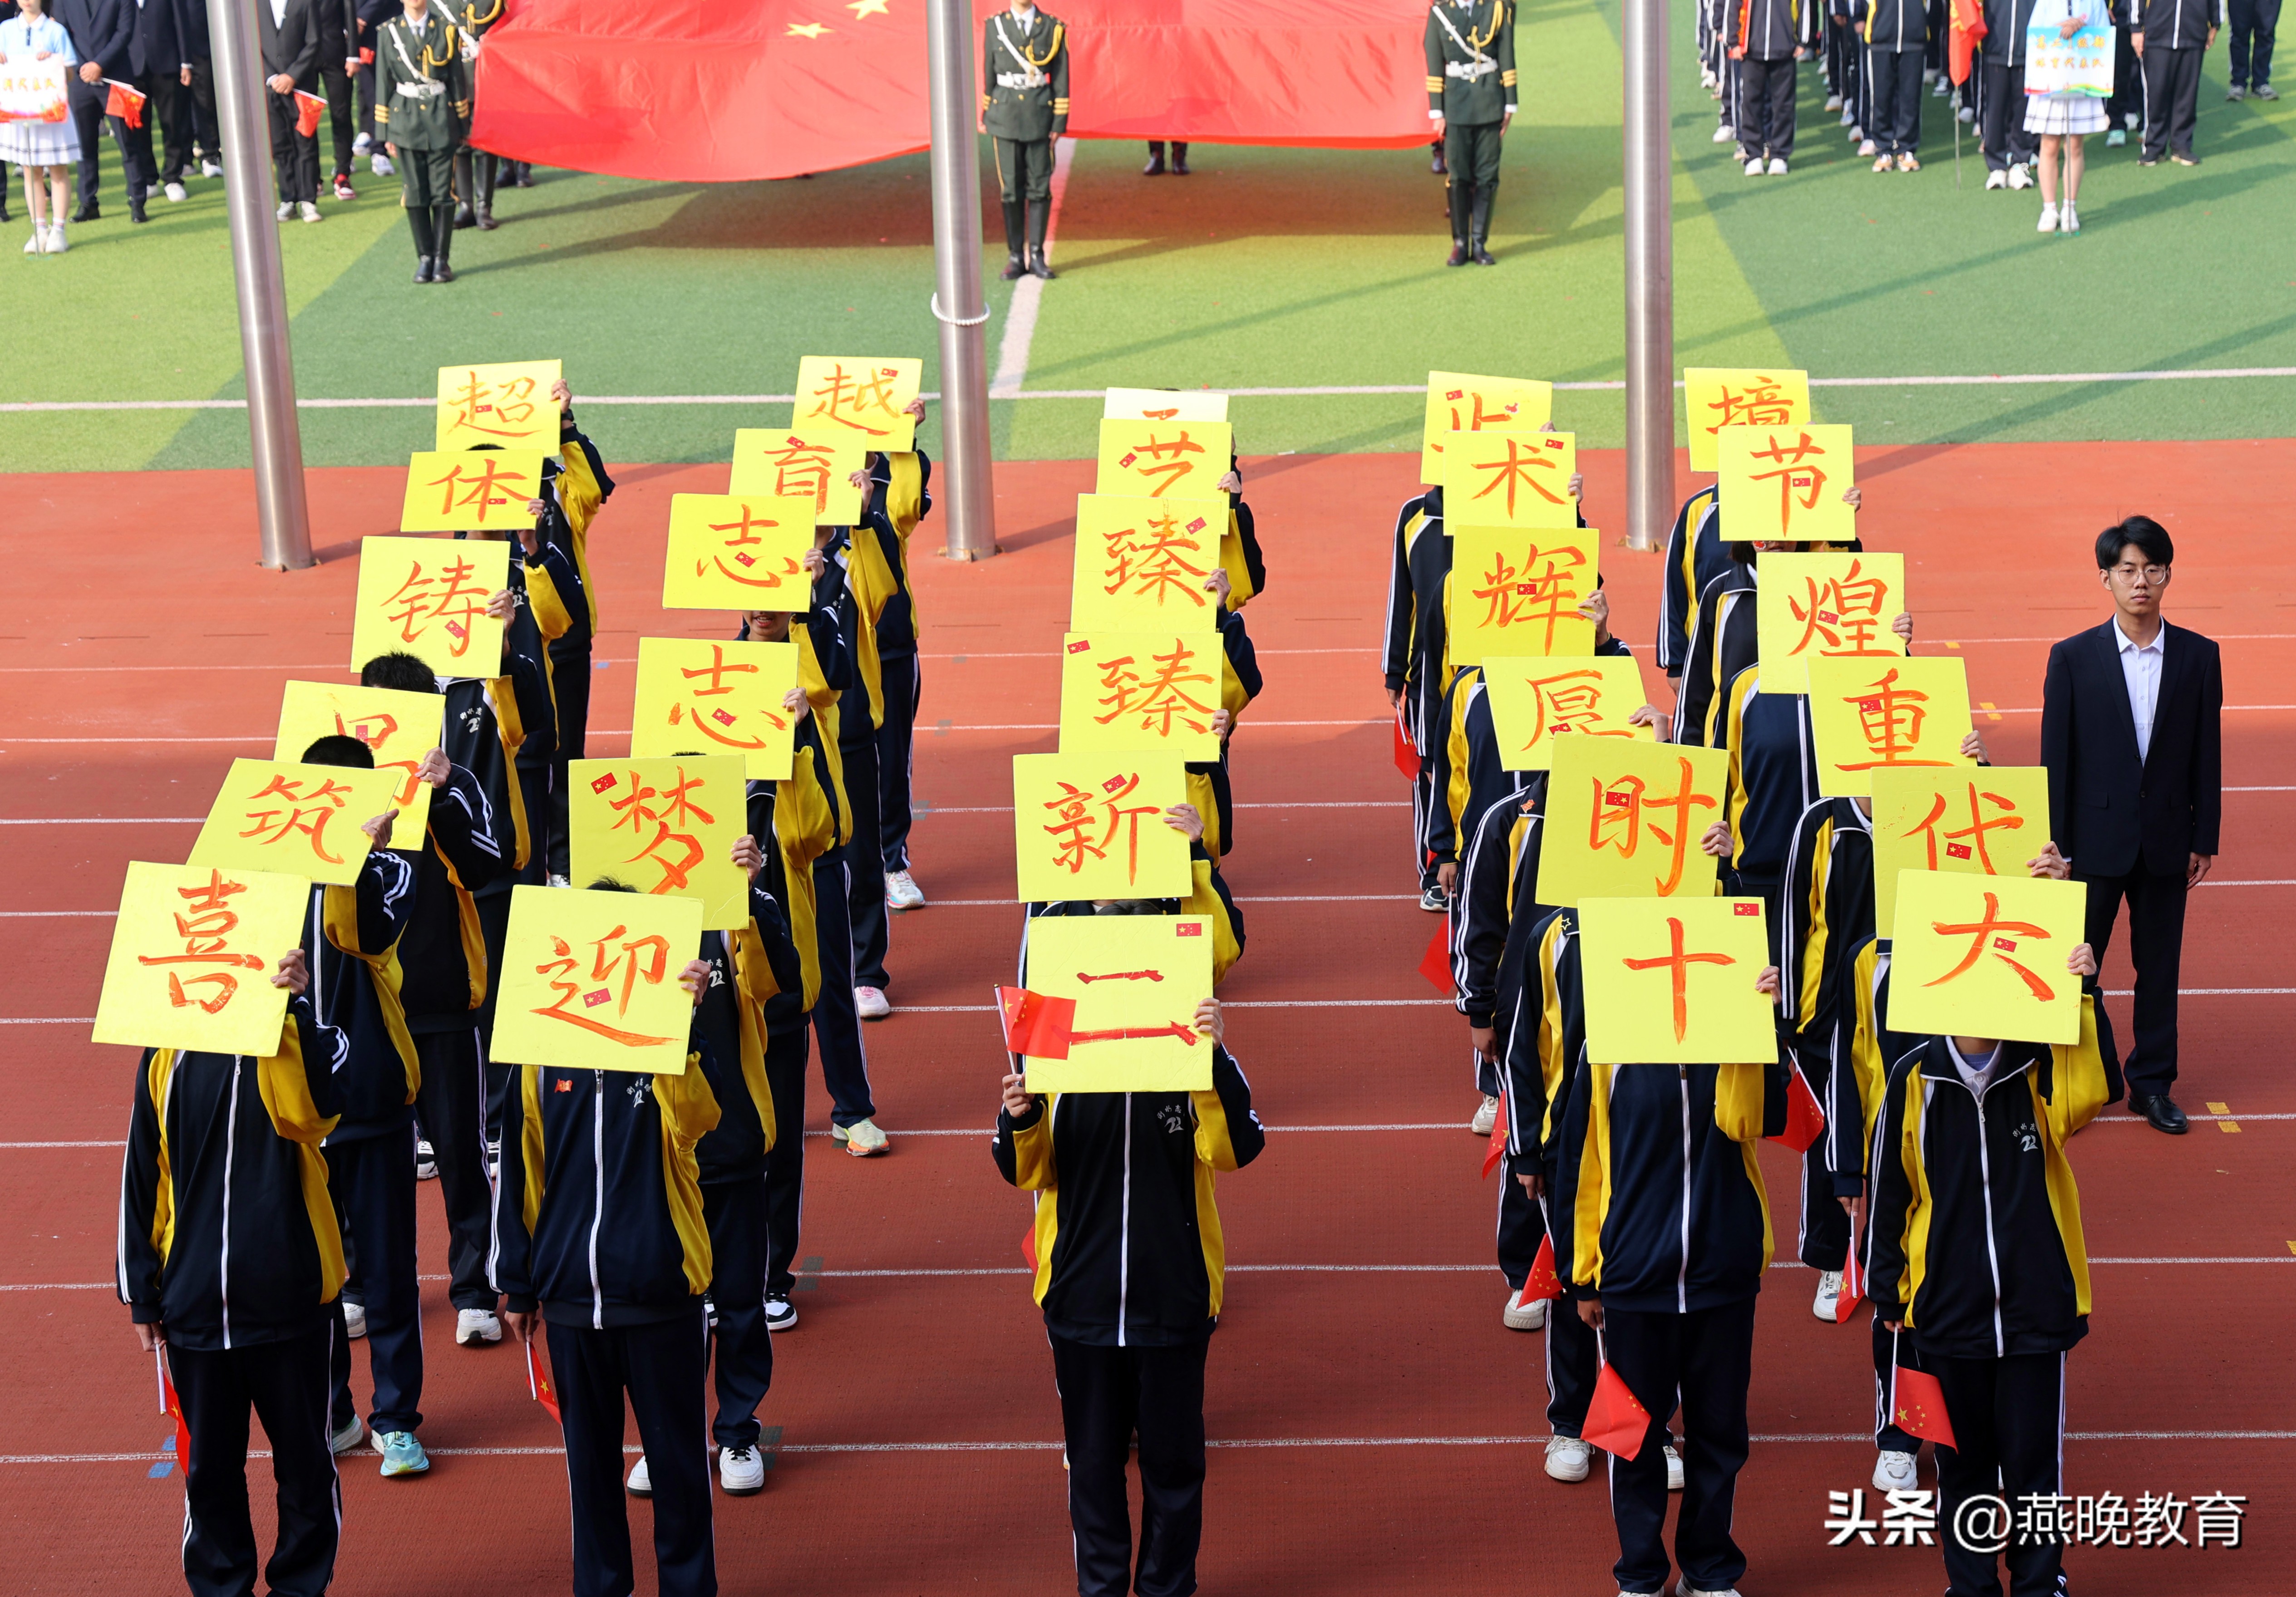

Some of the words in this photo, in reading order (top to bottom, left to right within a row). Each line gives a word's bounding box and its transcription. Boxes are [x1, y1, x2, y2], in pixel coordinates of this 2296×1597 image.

[447, 371, 542, 437] 超
[808, 364, 900, 436] 越
[426, 459, 533, 522] 体
[764, 437, 836, 515] 育
[1471, 438, 1569, 519] 术
[1749, 432, 1828, 537] 节
[696, 503, 799, 588] 志
[1102, 514, 1211, 607] 臻
[380, 555, 491, 657] 铸
[1472, 543, 1585, 656] 辉
[1788, 558, 1900, 657] 煌
[668, 644, 787, 749] 志
[1094, 638, 1215, 737] 臻
[1834, 667, 1956, 772] 重
[239, 774, 353, 864] 筑
[608, 765, 715, 894] 梦
[1044, 772, 1161, 886] 新
[1589, 756, 1718, 898] 时
[1900, 781, 2024, 875] 代
[138, 868, 265, 1014] 喜
[529, 924, 683, 1047] 迎
[1621, 917, 1737, 1045] 十
[1922, 891, 2055, 1002] 大
[1064, 969, 1202, 1047] 二
